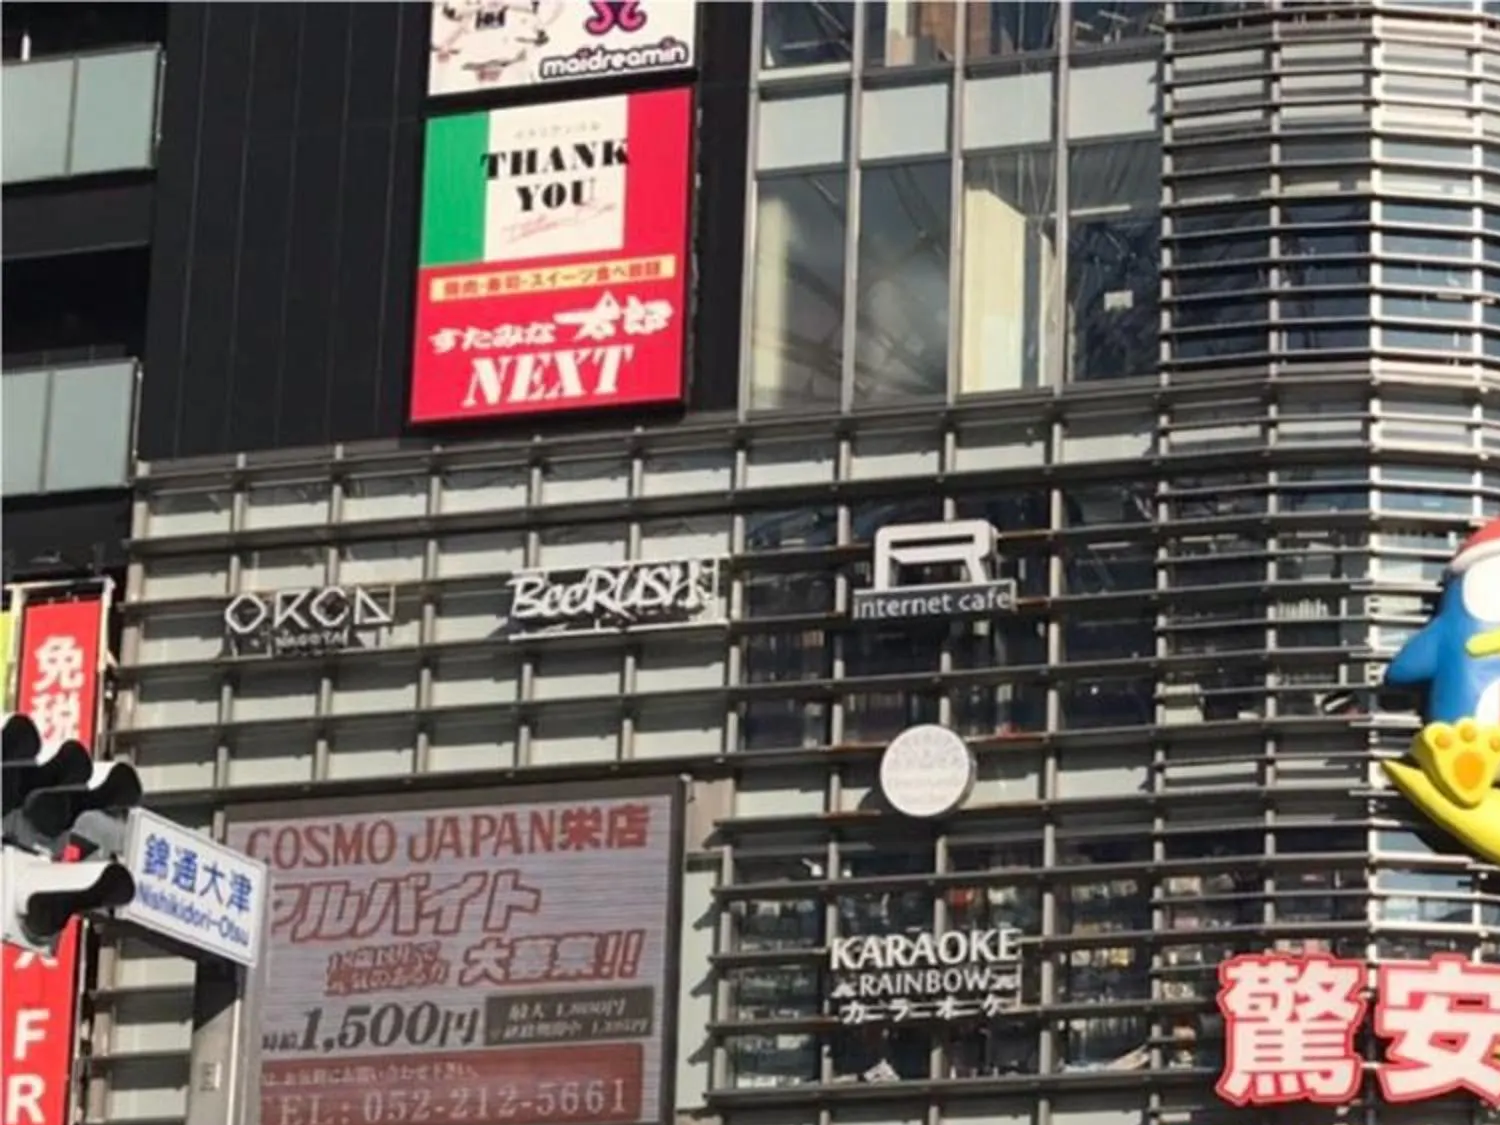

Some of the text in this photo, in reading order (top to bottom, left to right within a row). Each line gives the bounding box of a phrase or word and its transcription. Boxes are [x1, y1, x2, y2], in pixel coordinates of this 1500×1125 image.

[540, 38, 688, 79] maidreamin
[480, 138, 630, 181] THANK
[516, 178, 598, 212] YOU
[461, 344, 634, 408] NEXT
[853, 592, 952, 619] internet
[247, 817, 396, 870] COSMO
[830, 928, 1022, 970] KARAOKE
[860, 968, 991, 997] RAINBOW
